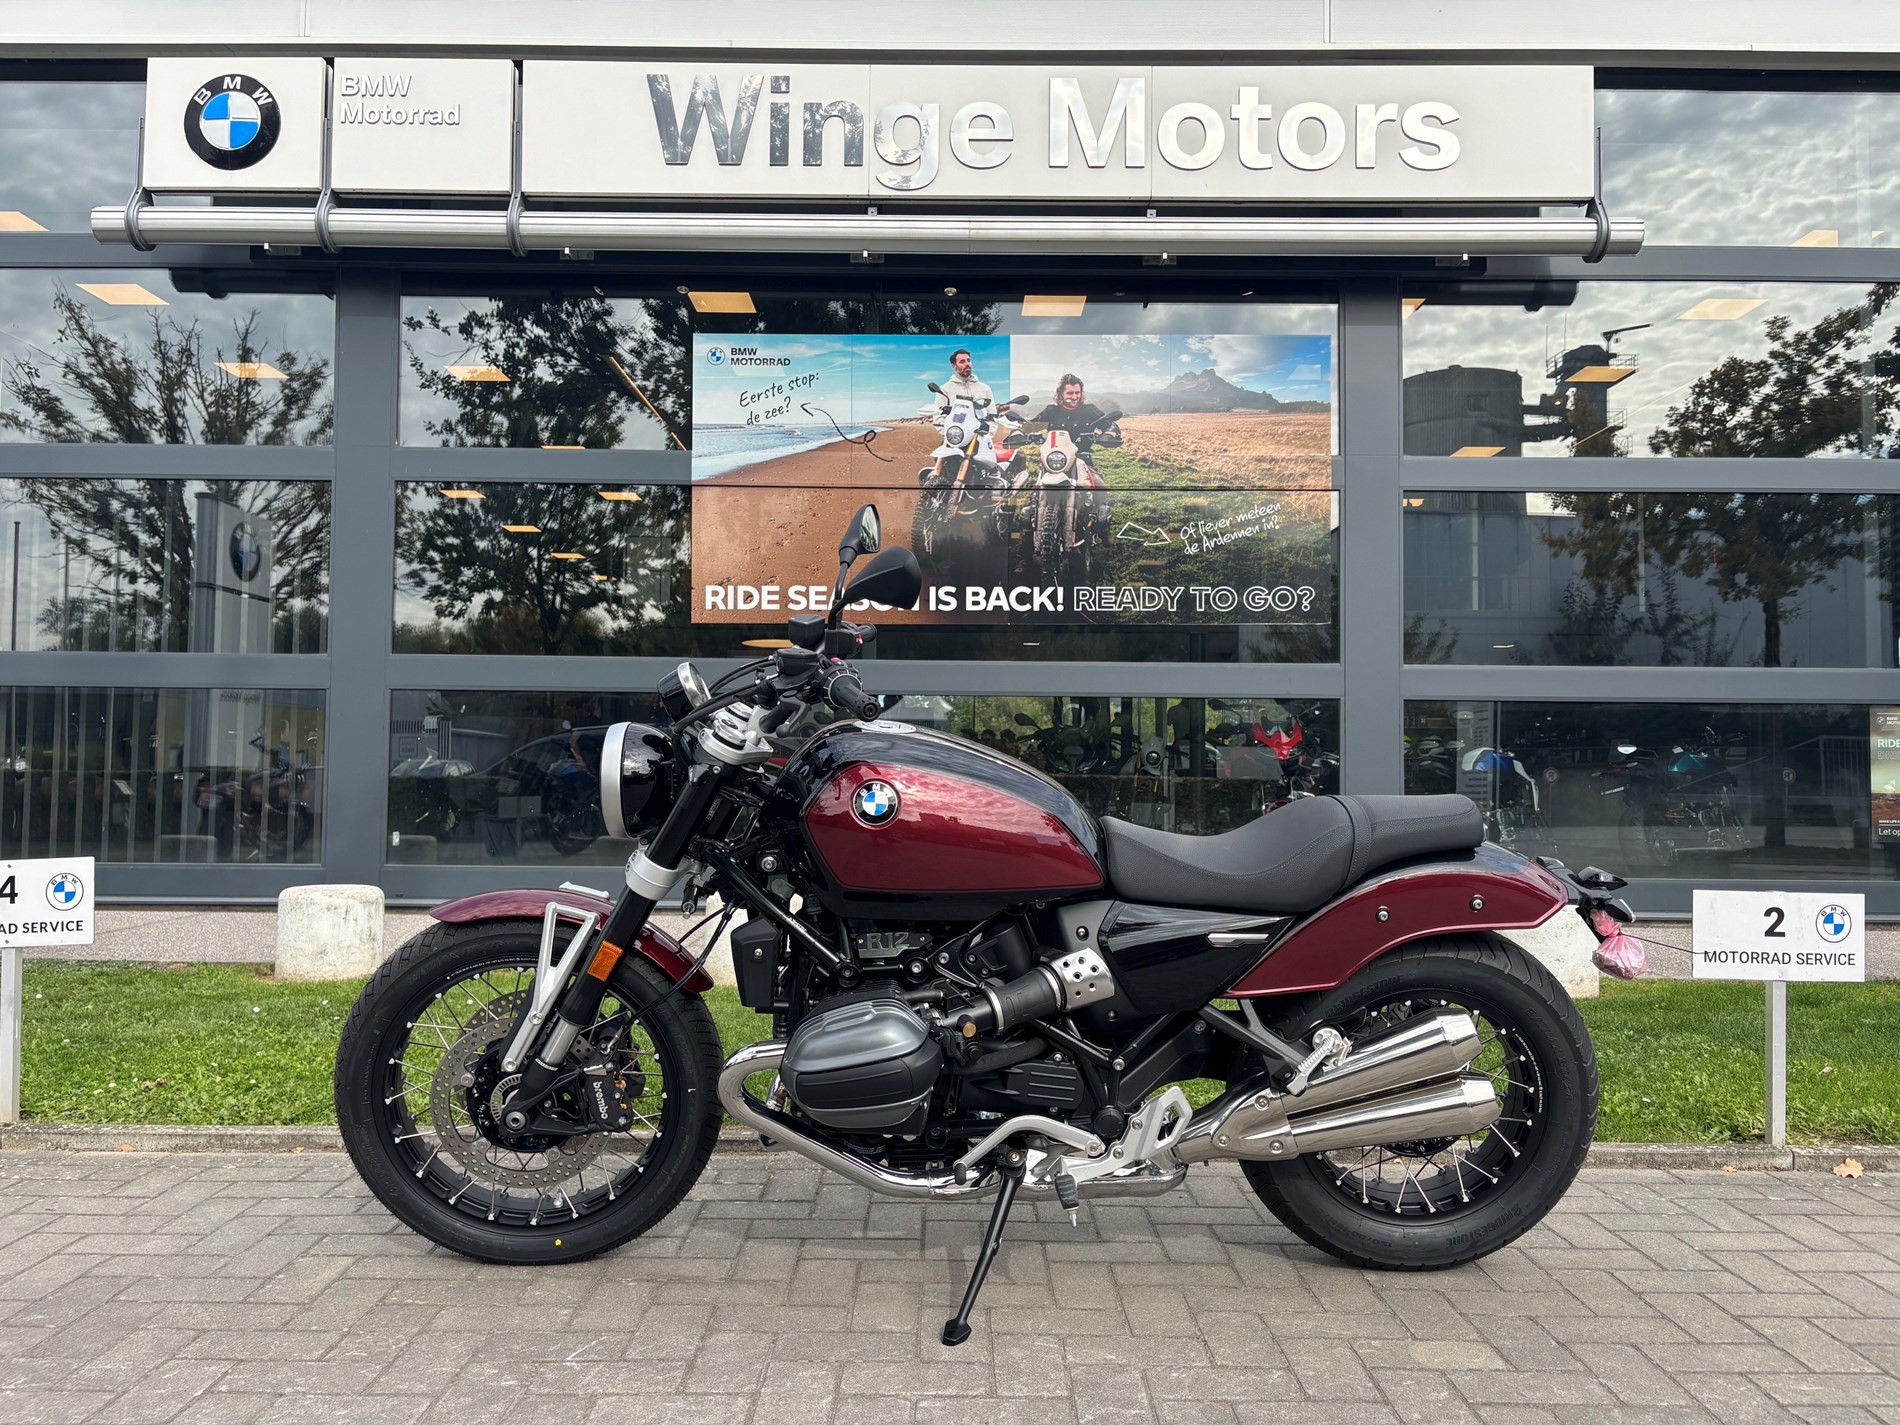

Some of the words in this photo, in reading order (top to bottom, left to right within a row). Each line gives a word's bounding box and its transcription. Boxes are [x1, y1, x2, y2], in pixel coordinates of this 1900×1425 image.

[193, 76, 274, 106] BMW
[340, 75, 412, 98] BMW
[340, 102, 461, 126] Motorrad
[646, 74, 1015, 191] Winge
[1047, 77, 1462, 171] Motors
[730, 347, 758, 356] BMW
[730, 357, 791, 366] MOTORRAD
[739, 382, 784, 408] Eerste
[788, 371, 820, 389] stop:
[746, 411, 761, 426] de
[764, 395, 792, 420] zee?
[1180, 522, 1196, 540] Of
[1199, 516, 1233, 536] liever
[1236, 502, 1282, 523] meteen
[1184, 540, 1200, 555] de
[1202, 525, 1260, 552] Ardennen
[1262, 514, 1280, 530] in?
[705, 584, 780, 611] RIDE
[929, 585, 958, 612] IS
[966, 586, 1065, 612] BACK!
[1073, 586, 1185, 612] READY
[1190, 586, 1238, 612] TO
[1243, 586, 1316, 612] GO?
[0, 875, 18, 905] 4
[22, 919, 84, 934] SERVICE
[1763, 906, 1786, 938] 2
[1703, 950, 1792, 965] MOTORRAD
[1796, 952, 1856, 966] SERVICE
[592, 1080, 609, 1120] brembo
